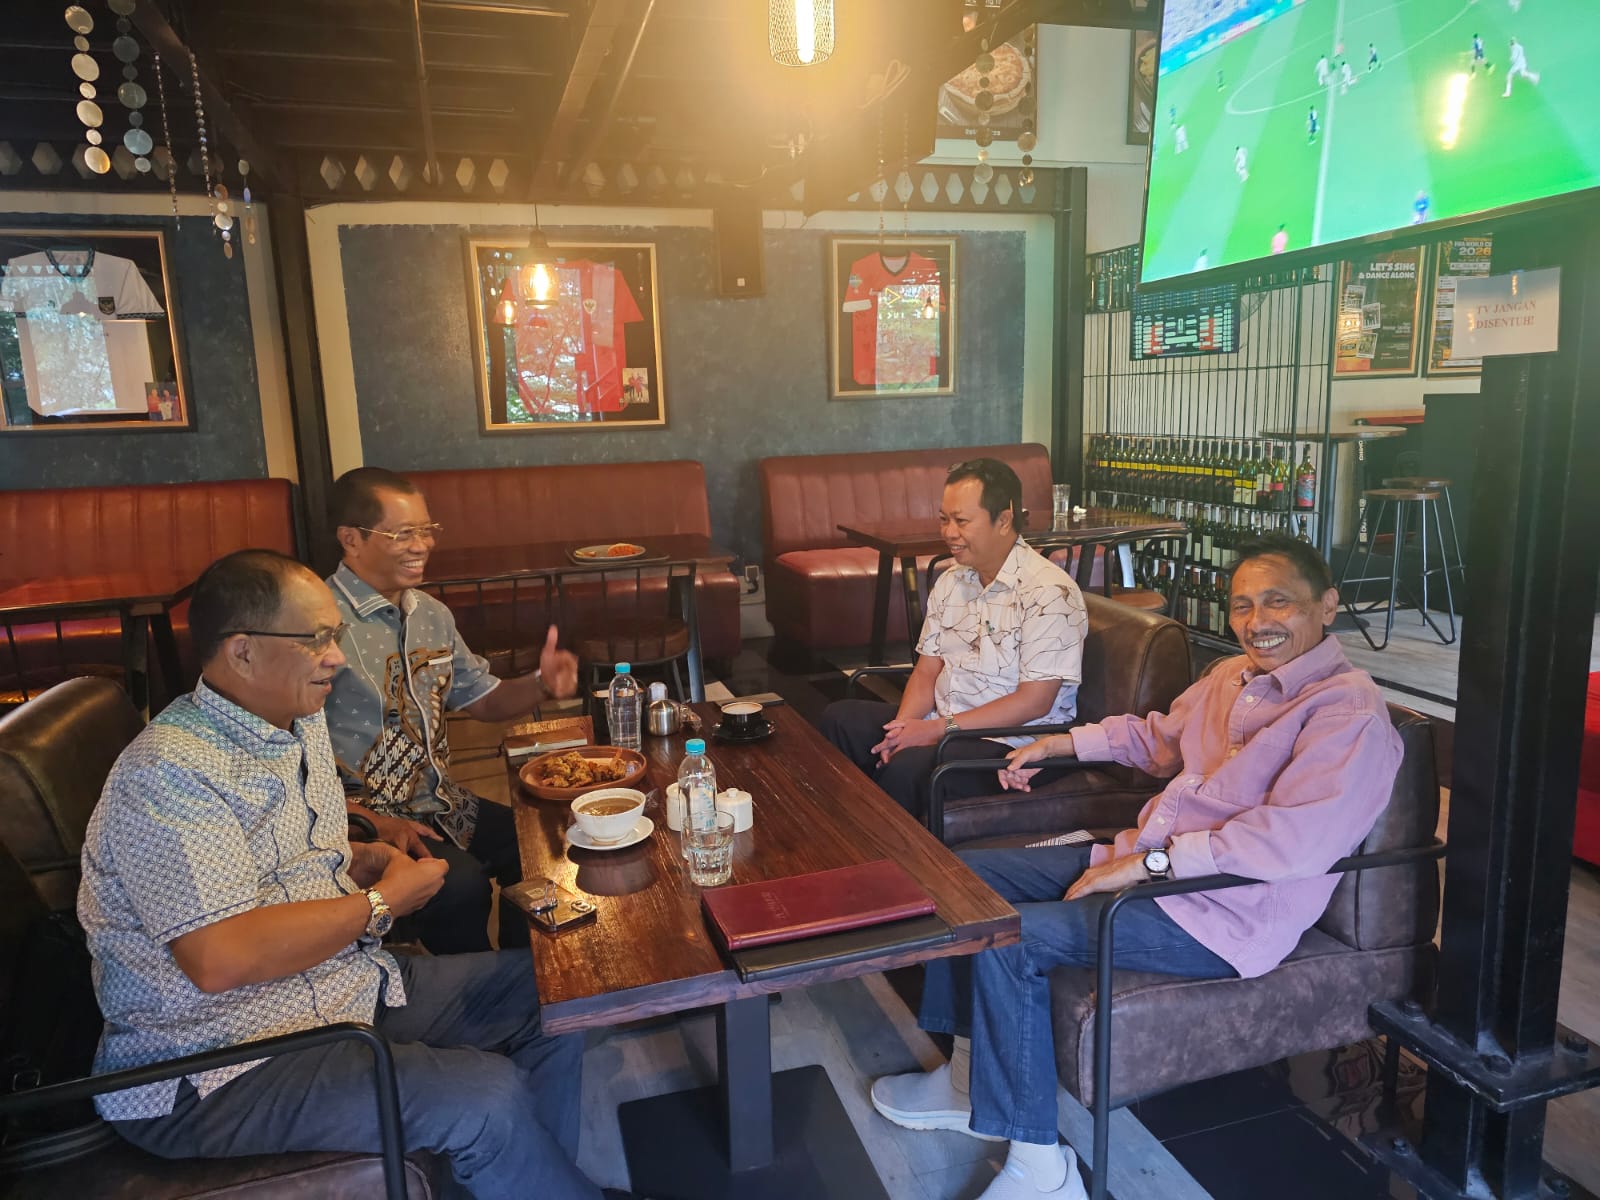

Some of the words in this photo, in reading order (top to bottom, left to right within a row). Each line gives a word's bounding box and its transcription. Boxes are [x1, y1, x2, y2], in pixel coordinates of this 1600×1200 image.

[1459, 247, 1491, 256] 2026
[1370, 262, 1394, 271] LET'S
[1394, 262, 1416, 271] SING
[1390, 271, 1415, 279] ALONG
[1477, 304, 1489, 315] TV
[1493, 300, 1537, 313] JANGAN
